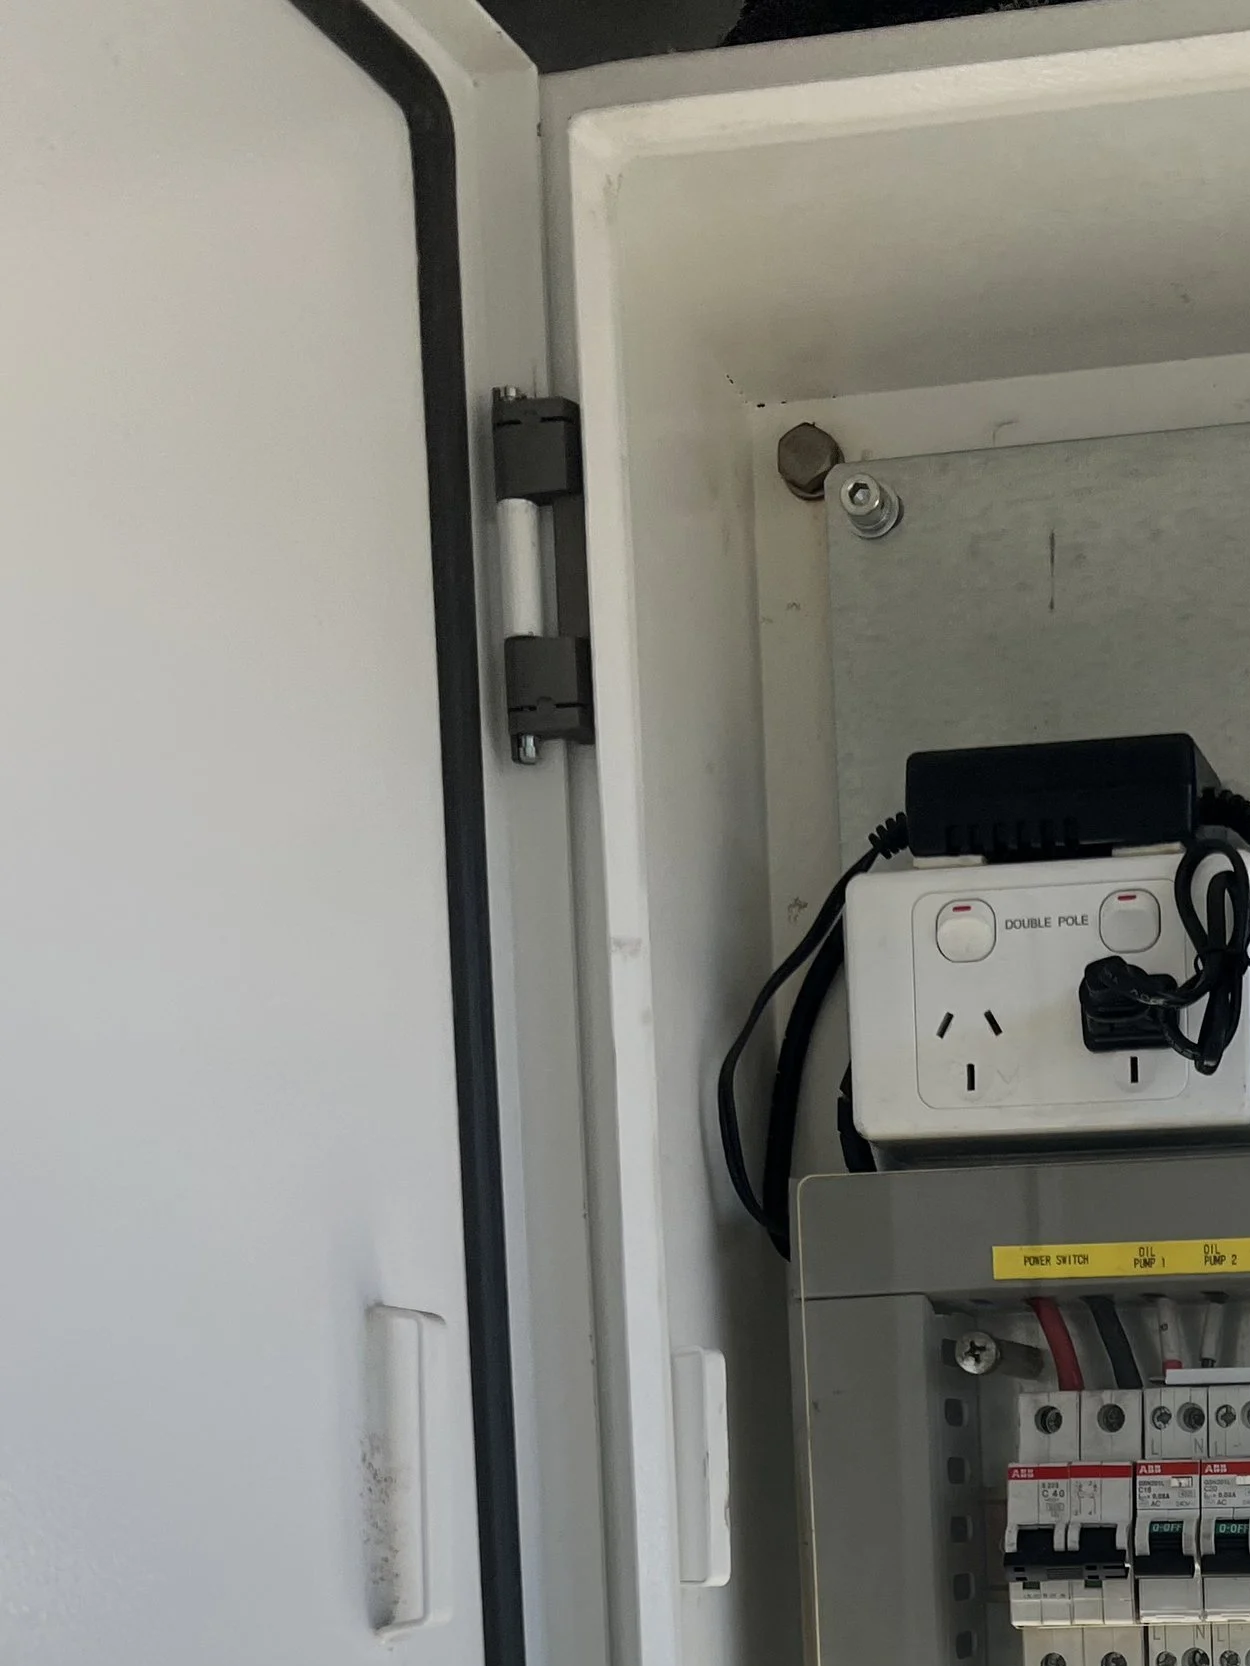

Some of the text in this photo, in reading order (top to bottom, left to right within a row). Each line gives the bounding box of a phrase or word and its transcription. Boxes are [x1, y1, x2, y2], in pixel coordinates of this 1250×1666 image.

[1004, 914, 1089, 930] DOUBLE POLE
[1138, 1246, 1156, 1257] OIL
[1203, 1244, 1221, 1254] OIL
[1023, 1254, 1089, 1266] POWER SWITCH
[1133, 1257, 1166, 1268] PUMP 1
[1204, 1254, 1238, 1266] PUMP 2
[1011, 1469, 1034, 1478] ABB
[1139, 1464, 1161, 1473] ABB
[1204, 1463, 1227, 1473] ABB
